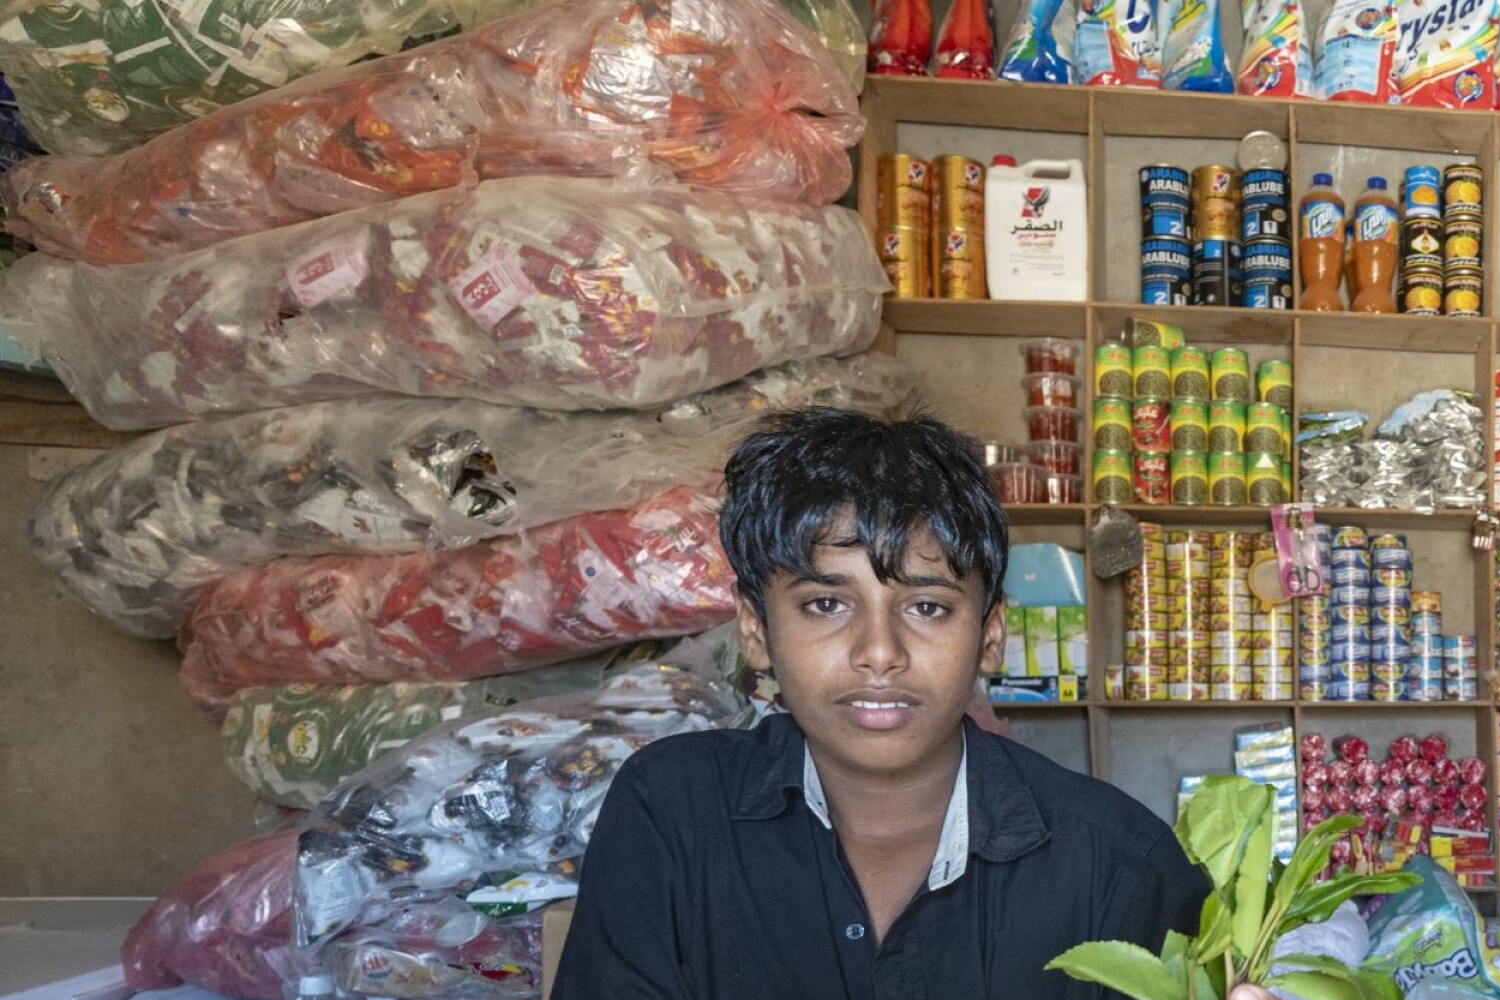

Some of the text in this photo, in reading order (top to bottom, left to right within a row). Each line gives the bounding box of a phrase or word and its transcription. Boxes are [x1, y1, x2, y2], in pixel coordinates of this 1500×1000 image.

[1150, 178, 1189, 195] ARABLU
[1244, 180, 1285, 195] ABLUBE
[1011, 220, 1063, 235] الصقر
[1169, 220, 1183, 236] 2
[1246, 222, 1258, 236] 2
[1154, 291, 1167, 305] 2
[1253, 294, 1266, 308] 2
